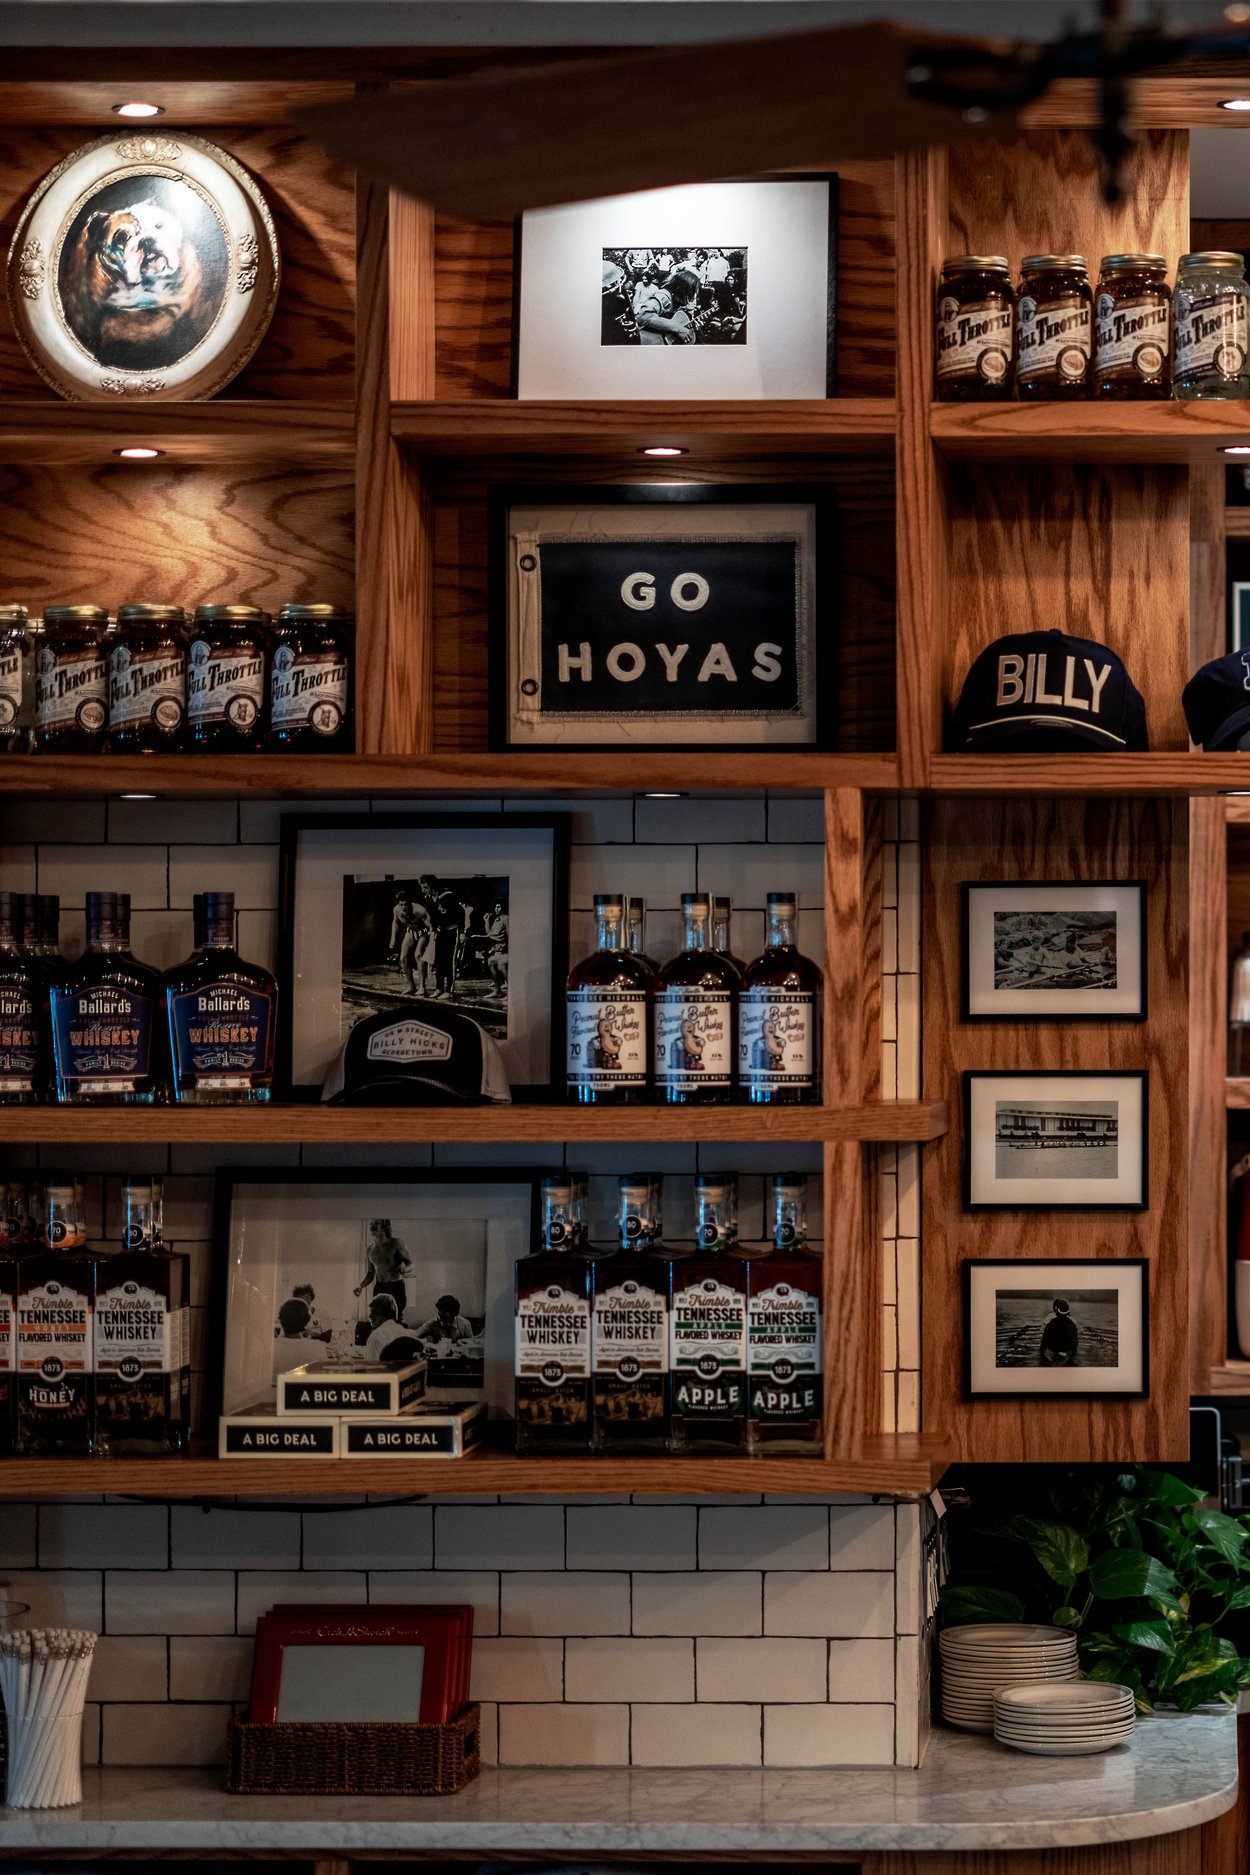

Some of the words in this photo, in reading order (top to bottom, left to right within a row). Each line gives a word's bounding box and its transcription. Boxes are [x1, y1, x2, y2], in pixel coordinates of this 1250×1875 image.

[621, 572, 710, 612] GO
[558, 640, 784, 683] HOYAS
[208, 661, 262, 692] THROTTLE
[292, 667, 346, 697] THROTTLE
[996, 653, 1112, 713] BILLY
[0, 991, 21, 999] CHAEL
[91, 991, 118, 999] MICHAEL
[210, 988, 238, 997] MICHAEL
[0, 999, 33, 1014] lard's
[79, 999, 131, 1014] Ballard's
[198, 997, 250, 1011] Ballard's
[606, 1004, 635, 1020] Butter
[688, 1005, 718, 1021] Butter
[769, 1006, 800, 1021] Butter
[1, 1030, 39, 1046] SKEY
[70, 1030, 140, 1046] WHISKEY
[189, 1027, 258, 1043] WHISKEY
[405, 1027, 434, 1039] STREET
[374, 1038, 404, 1049] BILLY
[410, 1038, 445, 1050] HICKS
[570, 1043, 581, 1055] 70
[656, 1044, 666, 1056] 70
[32, 1297, 74, 1309] Trimble
[110, 1297, 151, 1310] Trimble
[609, 1297, 651, 1310] Trimble
[689, 1294, 730, 1307] Trimble
[762, 1298, 804, 1311] Trimble
[533, 1301, 575, 1314] Trimble
[676, 1307, 742, 1321] TENNESSEE
[19, 1310, 86, 1324] TENNESSEE
[97, 1311, 164, 1324] TENNESSEE
[520, 1315, 587, 1329] TENNESSEE
[596, 1310, 663, 1324] TENNESSEE
[750, 1312, 816, 1325] TENNESSEE
[19, 1333, 52, 1342] FLAVORED
[54, 1333, 86, 1342] WHISKEY
[104, 1326, 157, 1340] WHISKEY
[527, 1331, 580, 1344] WHISKEY
[603, 1326, 656, 1339] WHISKEY
[675, 1330, 709, 1340] FLAVORED
[711, 1330, 742, 1340] WHISKEY
[750, 1335, 783, 1344] FLAVORED
[785, 1335, 816, 1344] WHISKEY
[44, 1364, 61, 1372] 1873
[121, 1364, 139, 1372] 1873
[544, 1368, 561, 1376] 1873
[621, 1364, 638, 1372] 1873
[700, 1361, 718, 1370] 1873
[774, 1365, 792, 1374] 1873
[29, 1387, 76, 1403] HONEY
[300, 1391, 310, 1402] A
[314, 1391, 338, 1402] BIG
[342, 1391, 375, 1402] DEAL
[678, 1386, 740, 1404] APPLE
[753, 1389, 814, 1409] APPLE
[243, 1434, 252, 1445] A
[256, 1434, 280, 1445] BIG
[284, 1434, 317, 1445] DEAL
[364, 1434, 373, 1445] A
[378, 1434, 401, 1445] BIG
[405, 1434, 438, 1445] DEAL
